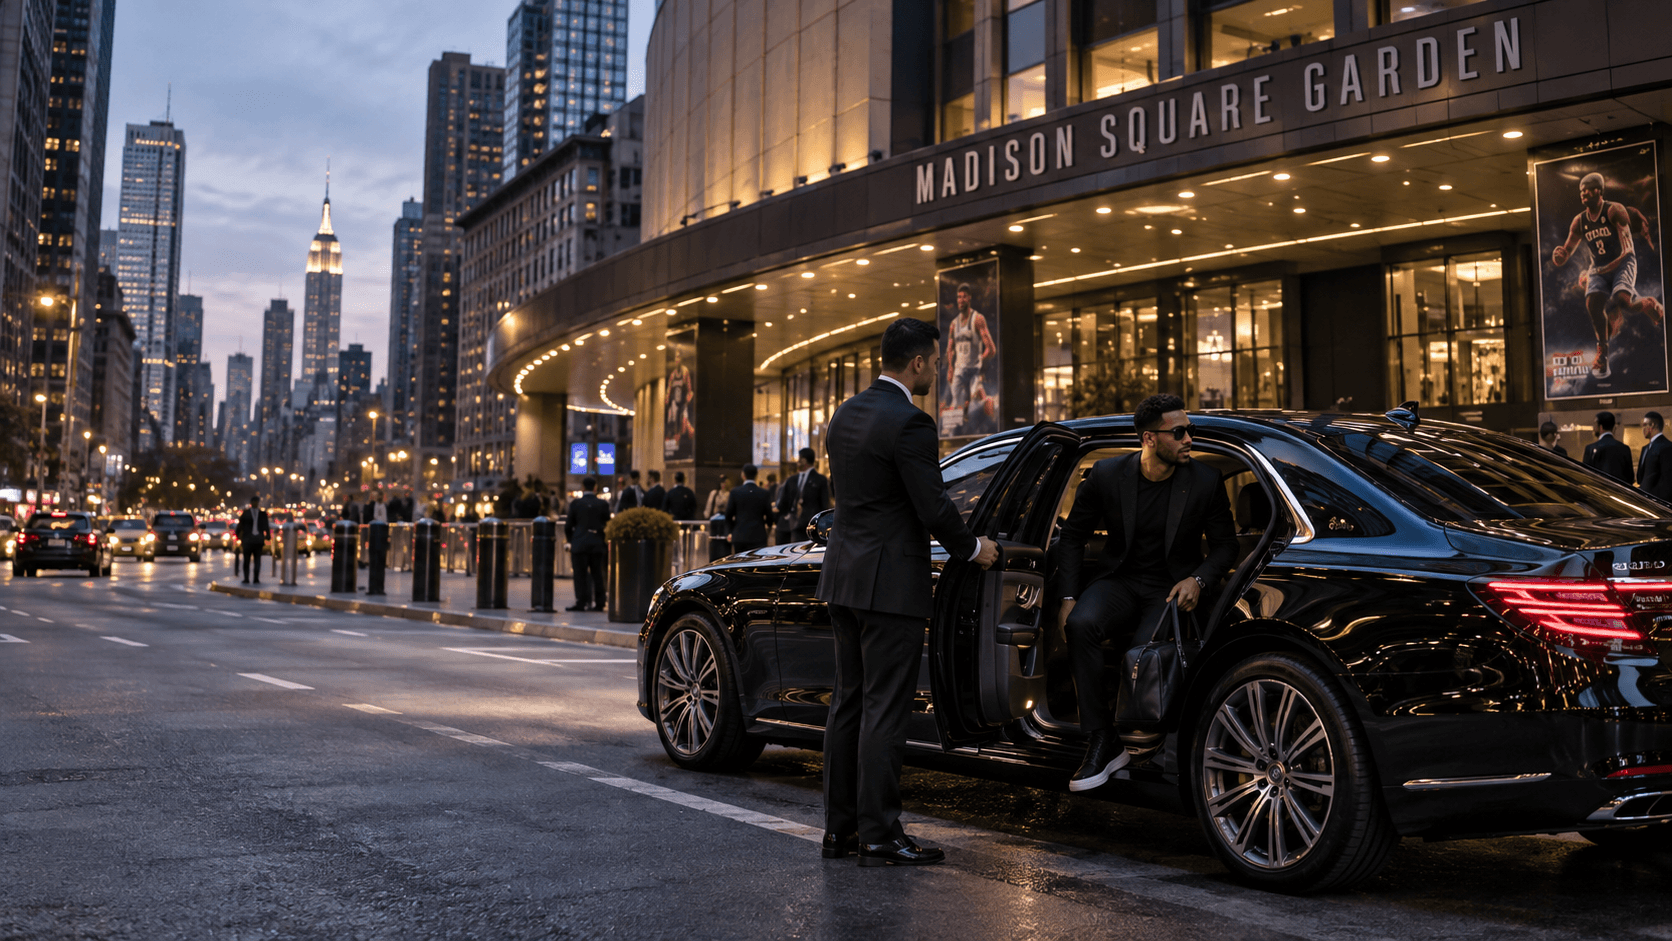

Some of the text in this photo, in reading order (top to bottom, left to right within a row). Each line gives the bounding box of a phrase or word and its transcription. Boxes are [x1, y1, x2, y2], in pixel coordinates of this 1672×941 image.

[916, 17, 1521, 204] MADISON SQUARE GARDEN
